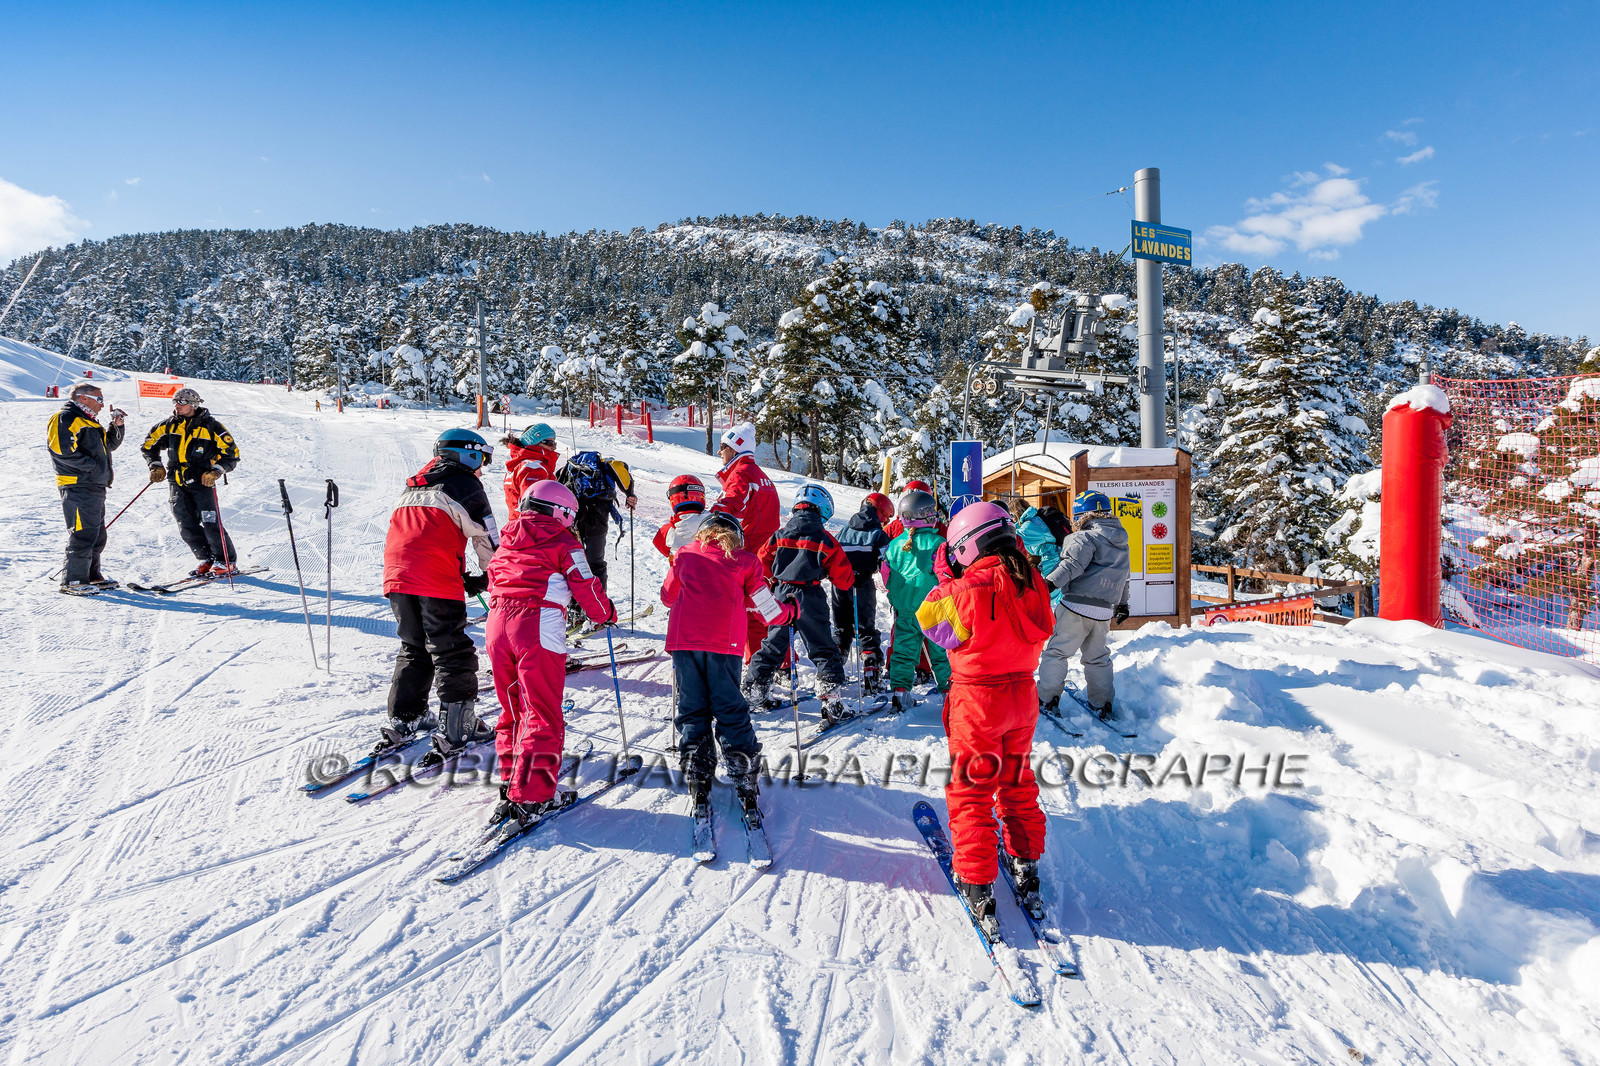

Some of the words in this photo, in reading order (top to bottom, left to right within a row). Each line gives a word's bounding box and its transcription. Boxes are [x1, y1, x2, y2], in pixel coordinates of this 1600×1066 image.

[1135, 226, 1155, 238] LES
[1134, 239, 1191, 261] LAVANDES
[1265, 607, 1312, 626] INTERDITES
